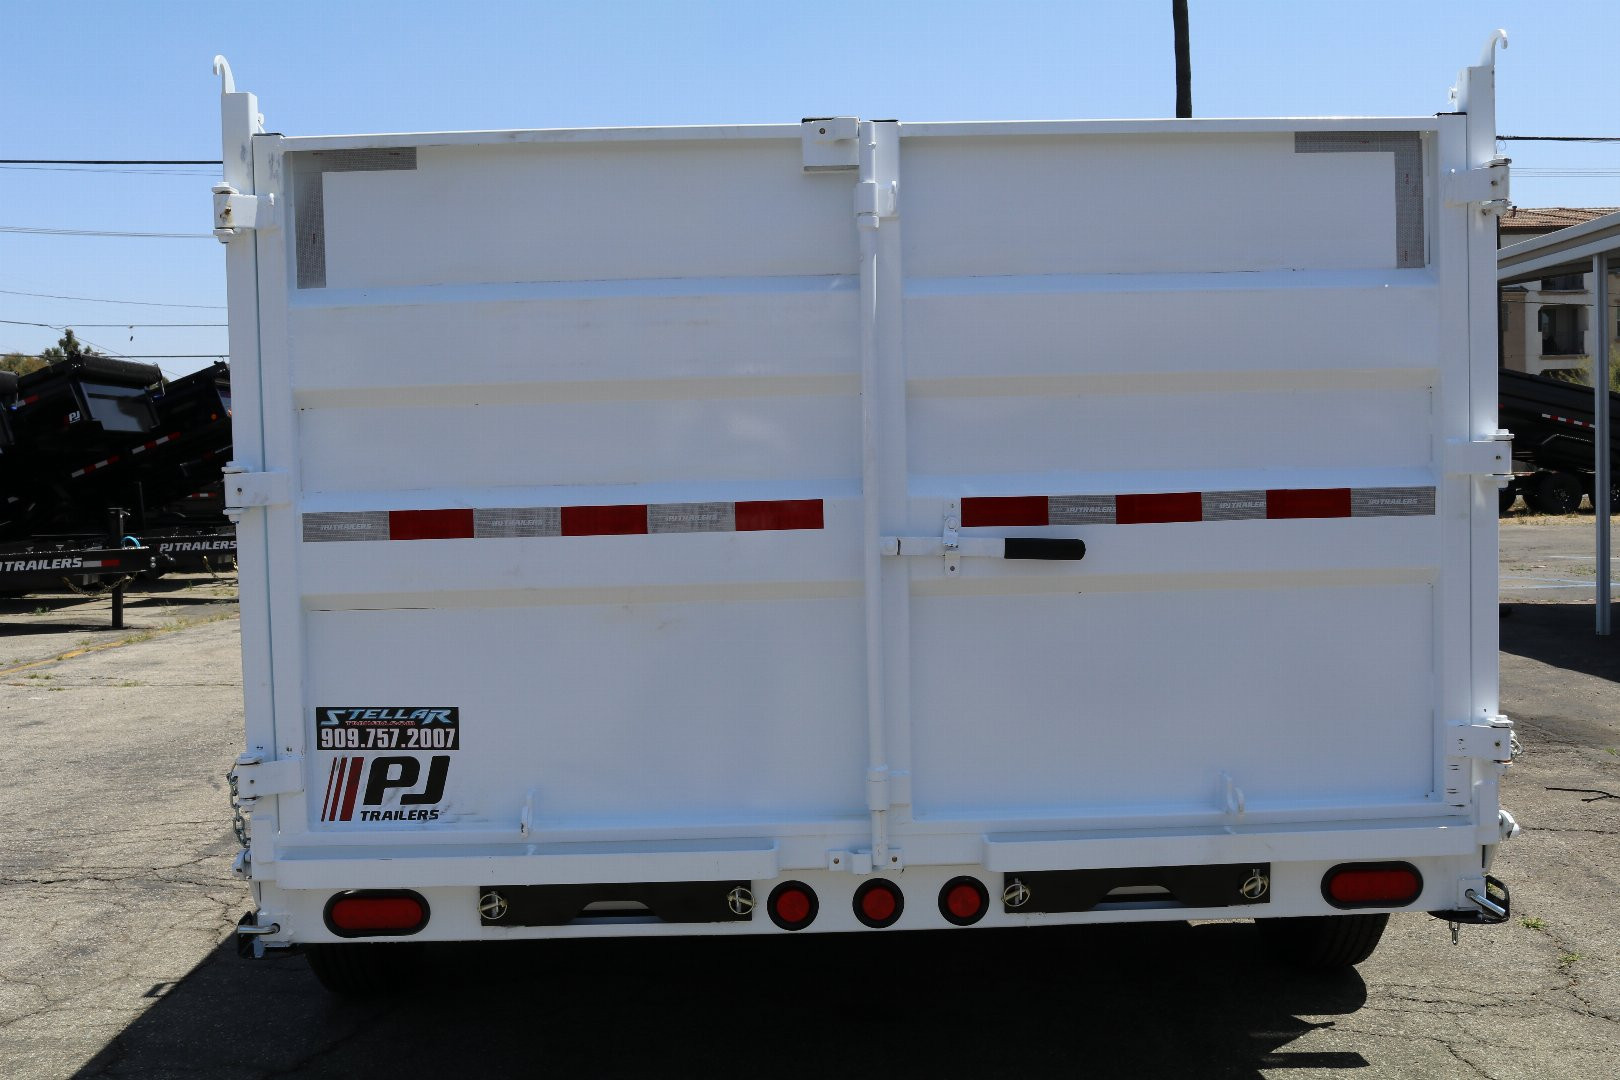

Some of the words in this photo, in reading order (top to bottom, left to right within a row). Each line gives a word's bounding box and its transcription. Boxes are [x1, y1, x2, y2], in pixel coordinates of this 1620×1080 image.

[69, 410, 80, 421] PJ
[320, 708, 454, 725] STELLAR
[321, 728, 456, 748] 909.757.2007
[363, 755, 451, 805] PJ
[360, 810, 440, 821] TRAILERS
